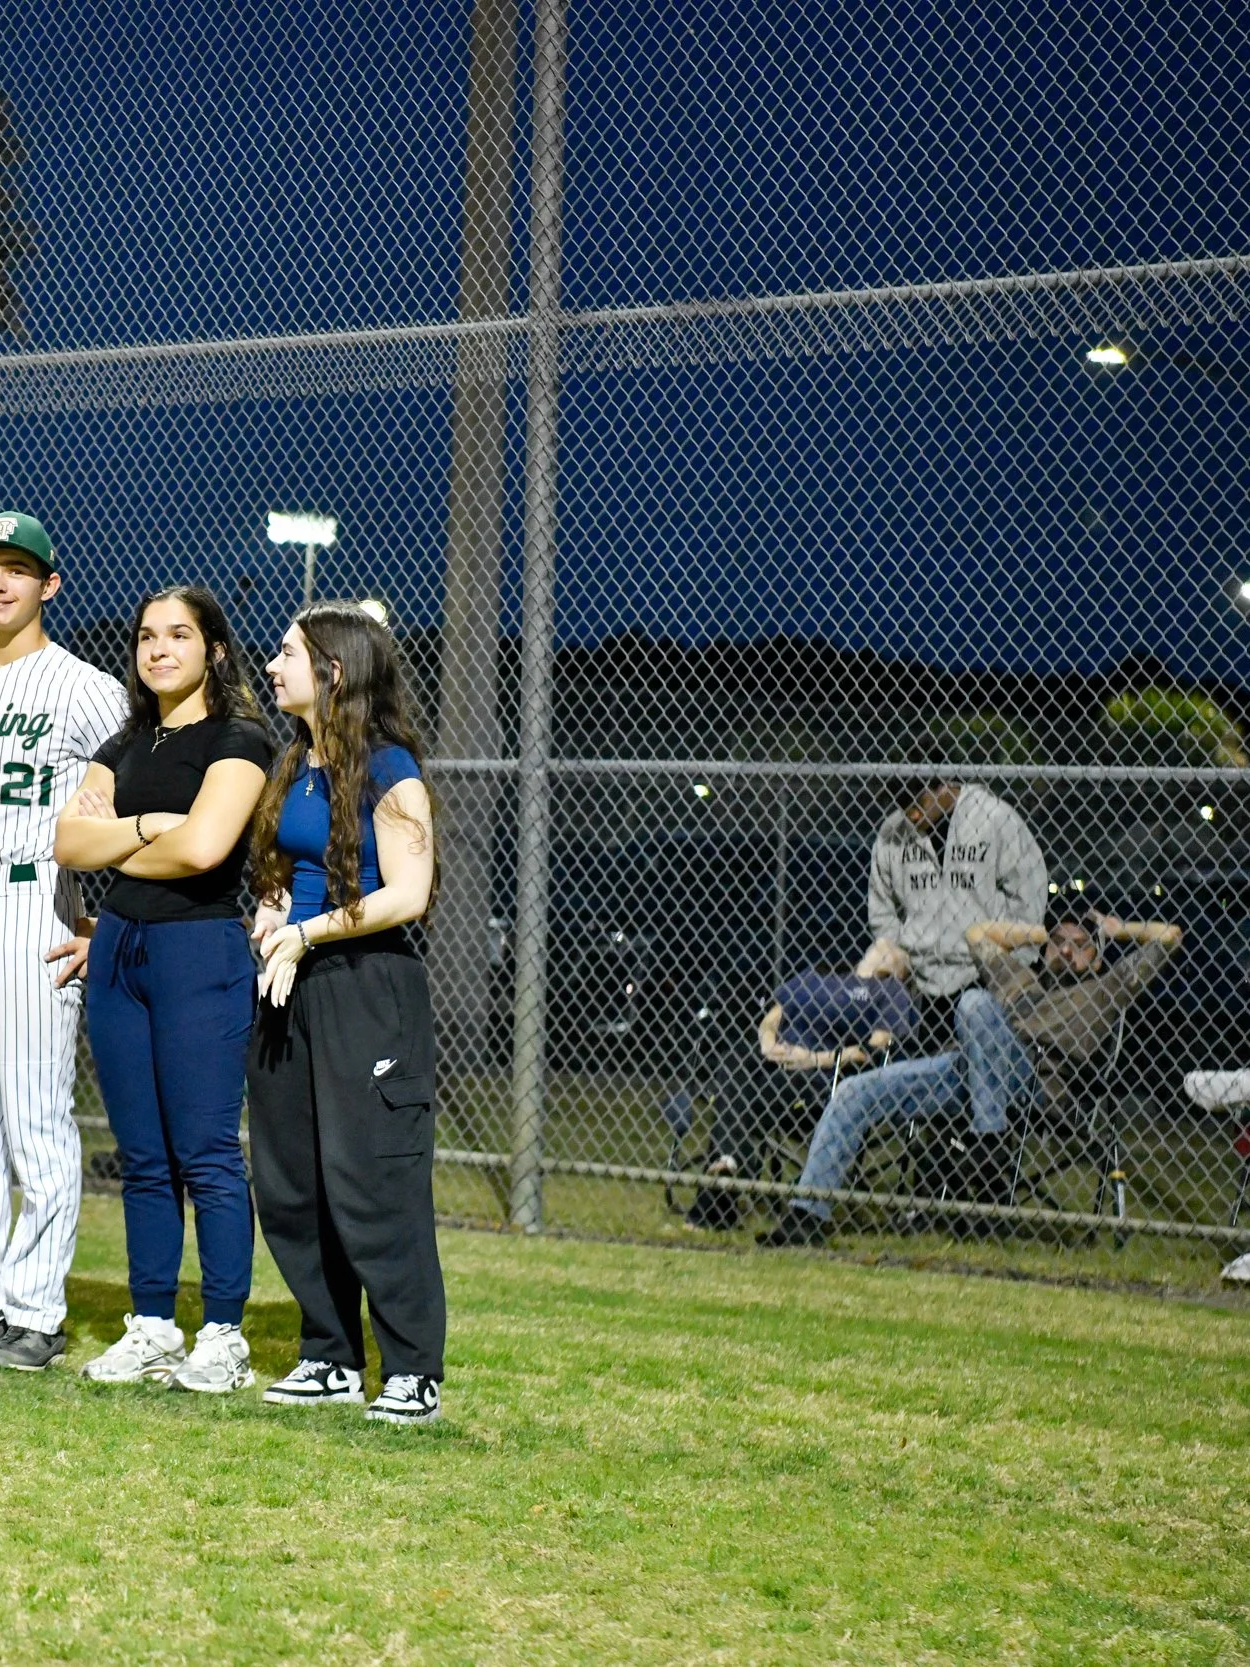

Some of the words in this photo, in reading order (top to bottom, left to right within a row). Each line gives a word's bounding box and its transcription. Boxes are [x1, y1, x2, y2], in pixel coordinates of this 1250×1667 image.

[0, 762, 55, 807] 21
[910, 873, 938, 891] NYC
[950, 872, 975, 891] USA
